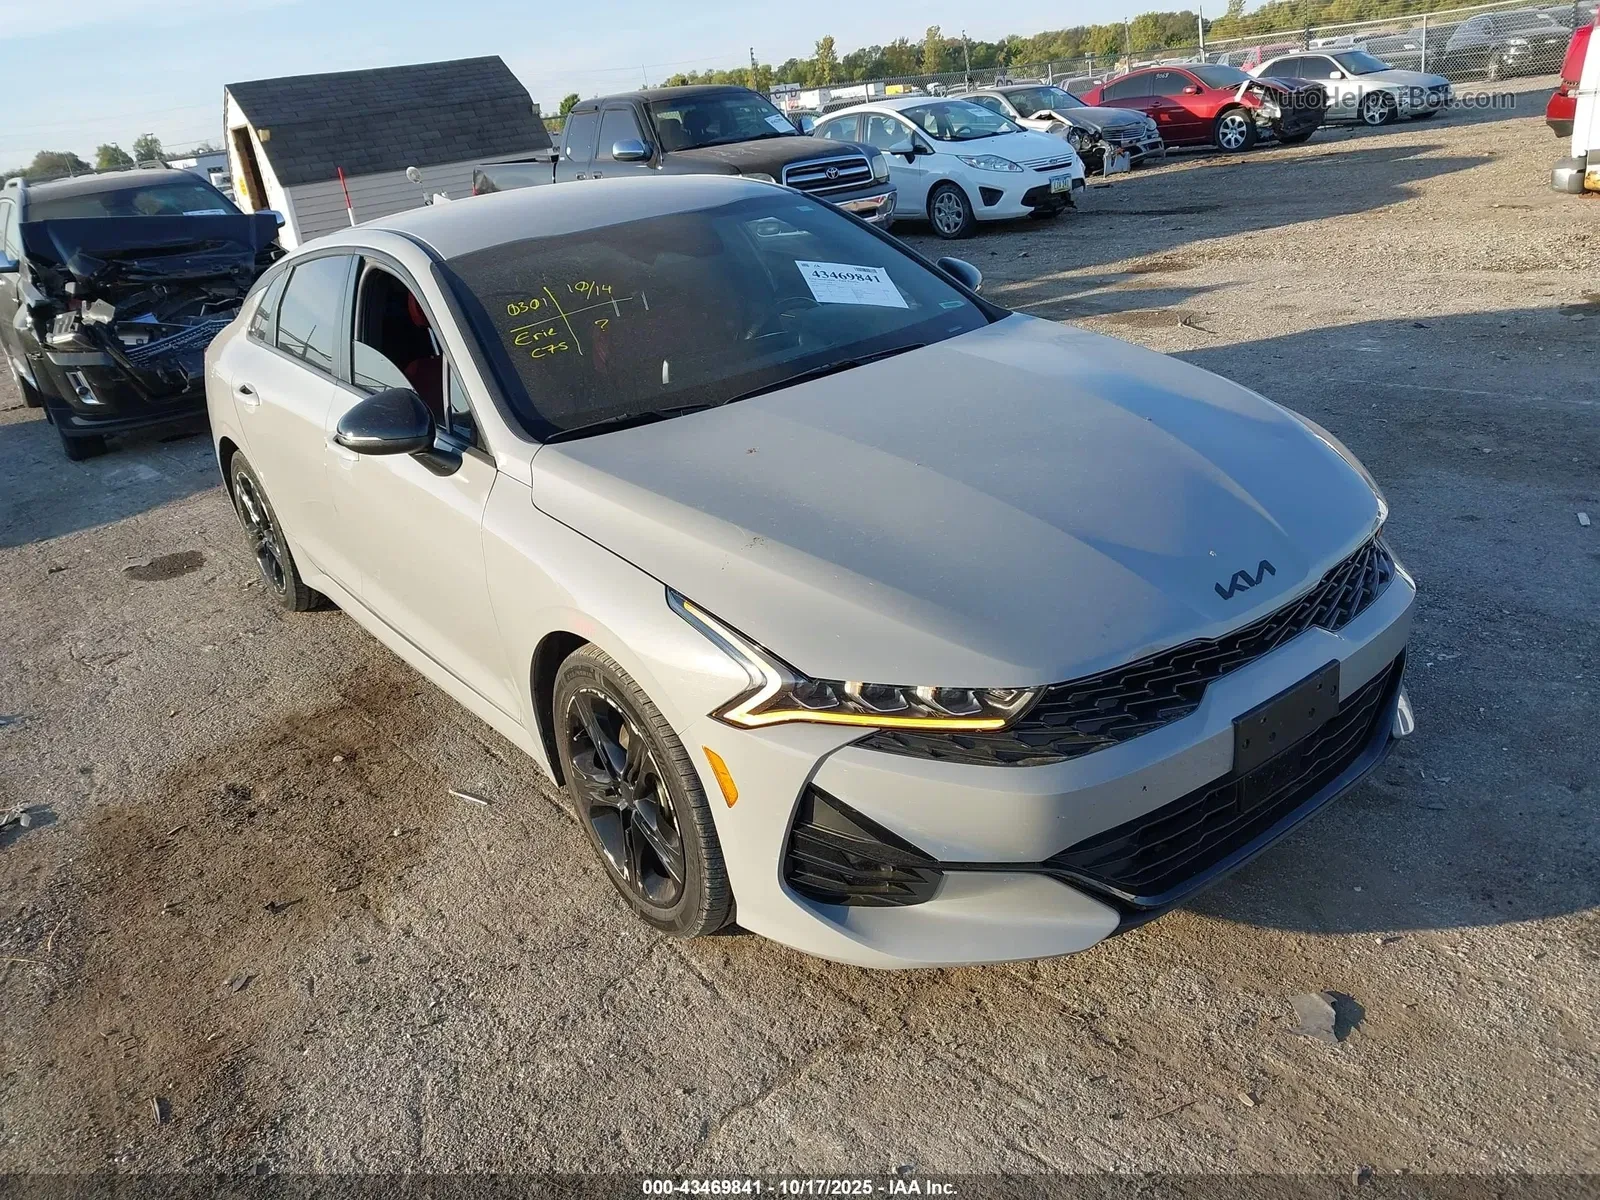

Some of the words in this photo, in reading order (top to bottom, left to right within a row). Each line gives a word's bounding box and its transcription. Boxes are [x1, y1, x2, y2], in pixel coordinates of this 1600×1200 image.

[811, 270, 881, 283] 43469841
[566, 280, 613, 300] 10/14
[514, 327, 558, 346] Erie
[1214, 559, 1277, 601] KIA
